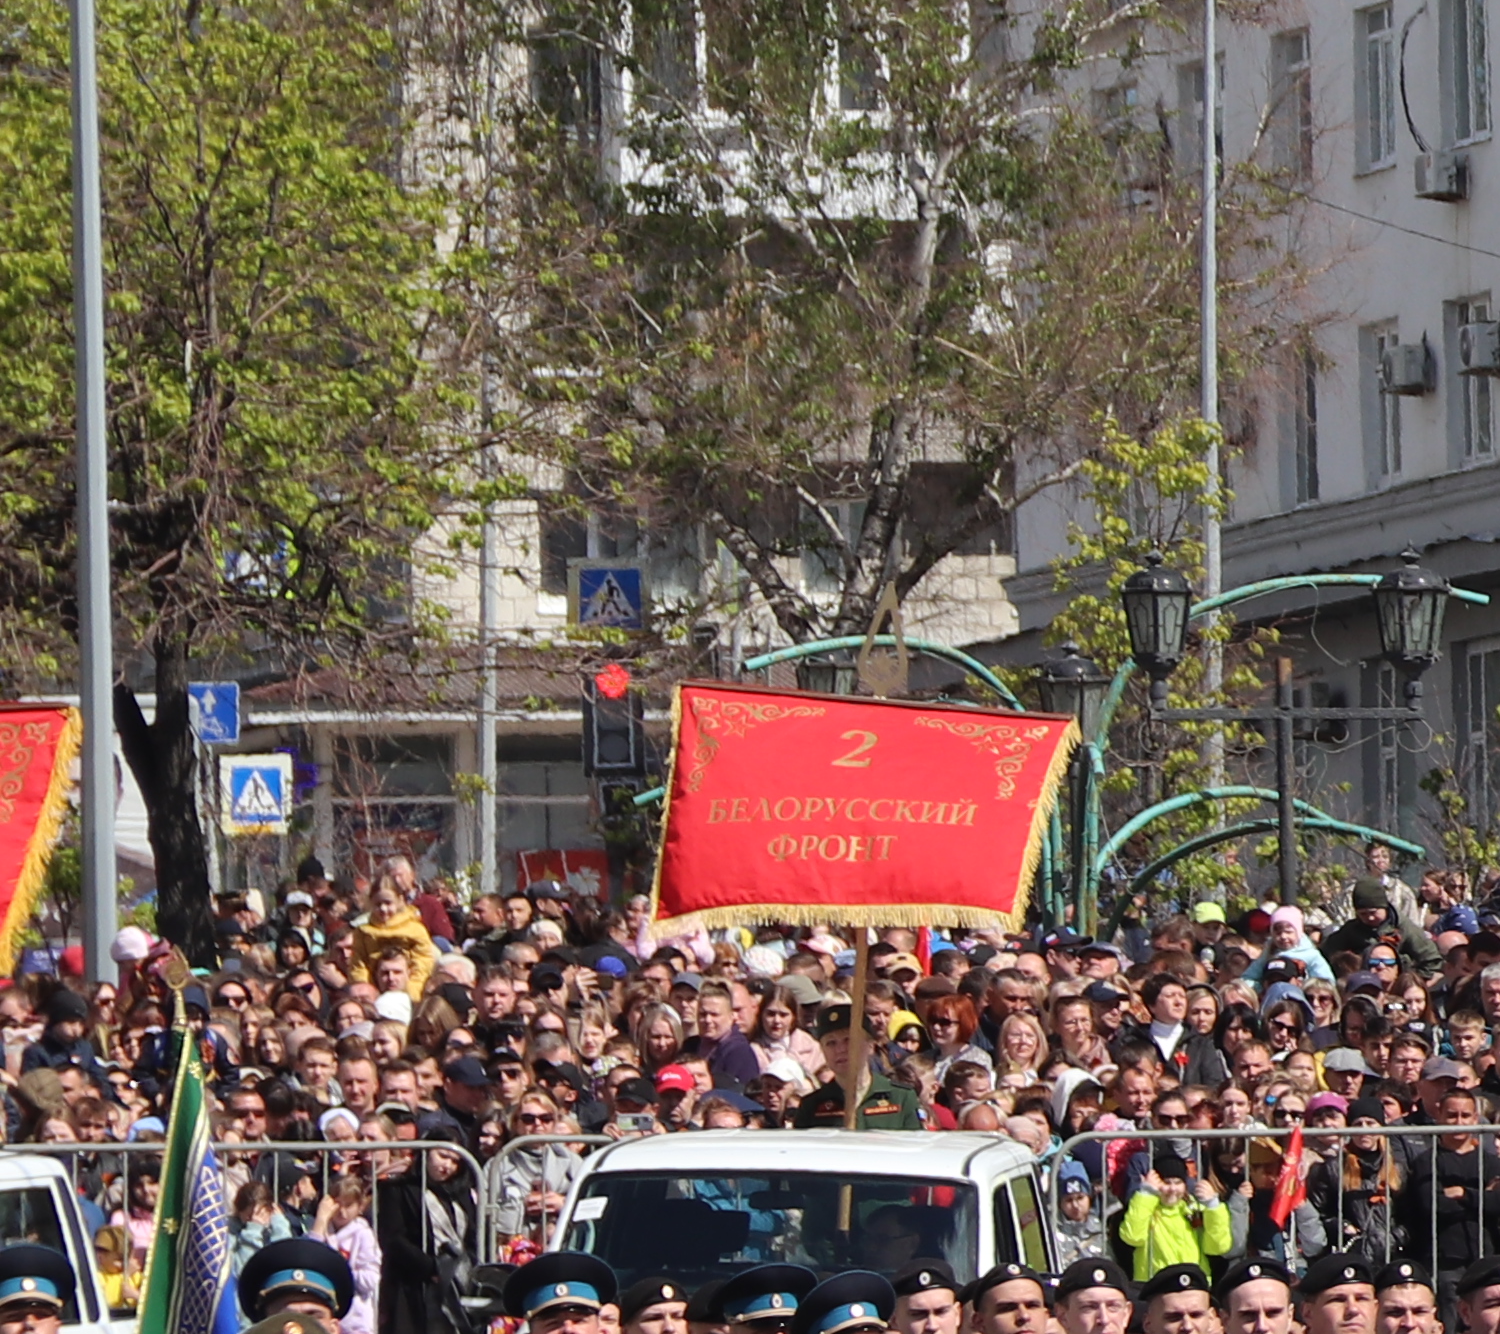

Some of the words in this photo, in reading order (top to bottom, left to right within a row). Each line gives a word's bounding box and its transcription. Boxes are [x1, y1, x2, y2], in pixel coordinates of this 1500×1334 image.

[831, 729, 878, 768] 2
[706, 796, 979, 826] БЕЛОРУССКИЙ
[767, 833, 898, 862] ФРОНТ
